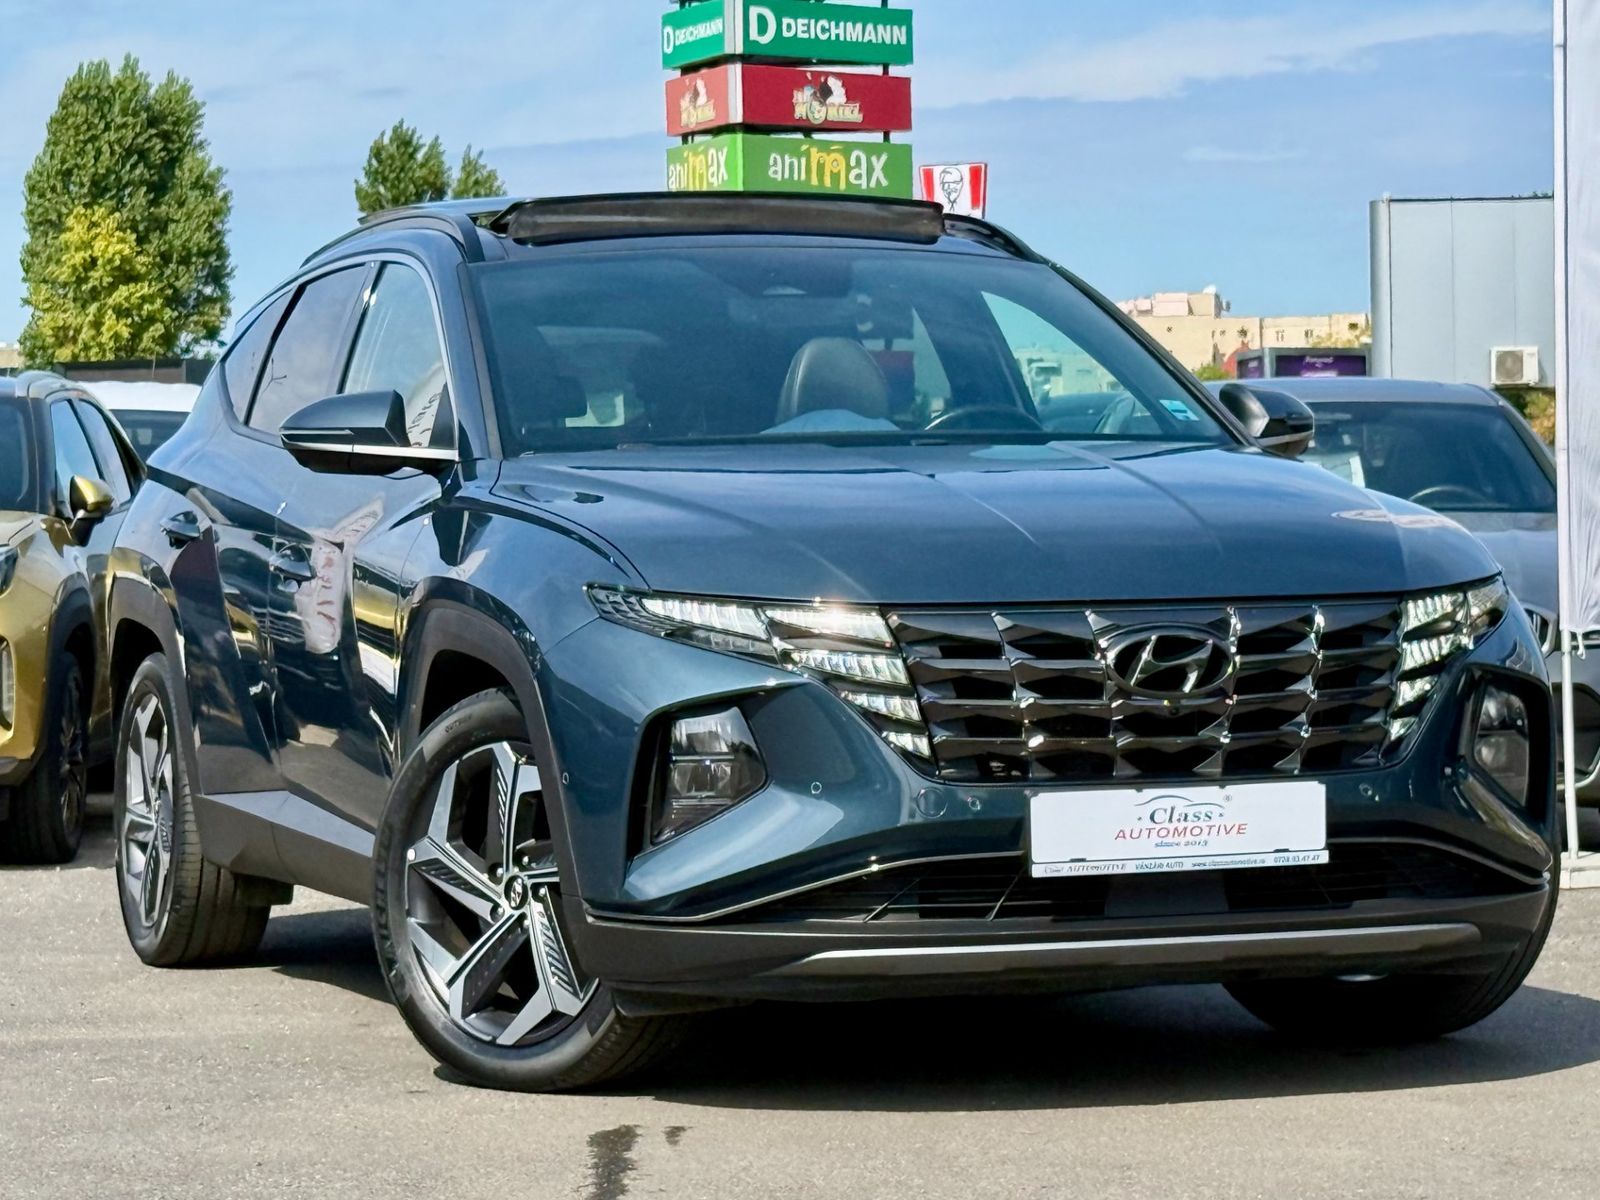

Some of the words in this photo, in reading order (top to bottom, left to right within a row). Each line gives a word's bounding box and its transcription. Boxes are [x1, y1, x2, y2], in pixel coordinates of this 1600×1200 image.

[674, 18, 723, 46] DEICHMANN
[749, 6, 777, 44] D
[782, 18, 907, 45] DEICHMANN
[669, 146, 728, 191] animax
[768, 145, 889, 191] animax
[1114, 822, 1249, 841] AUTOMOTIVE
[1149, 806, 1213, 825] Class
